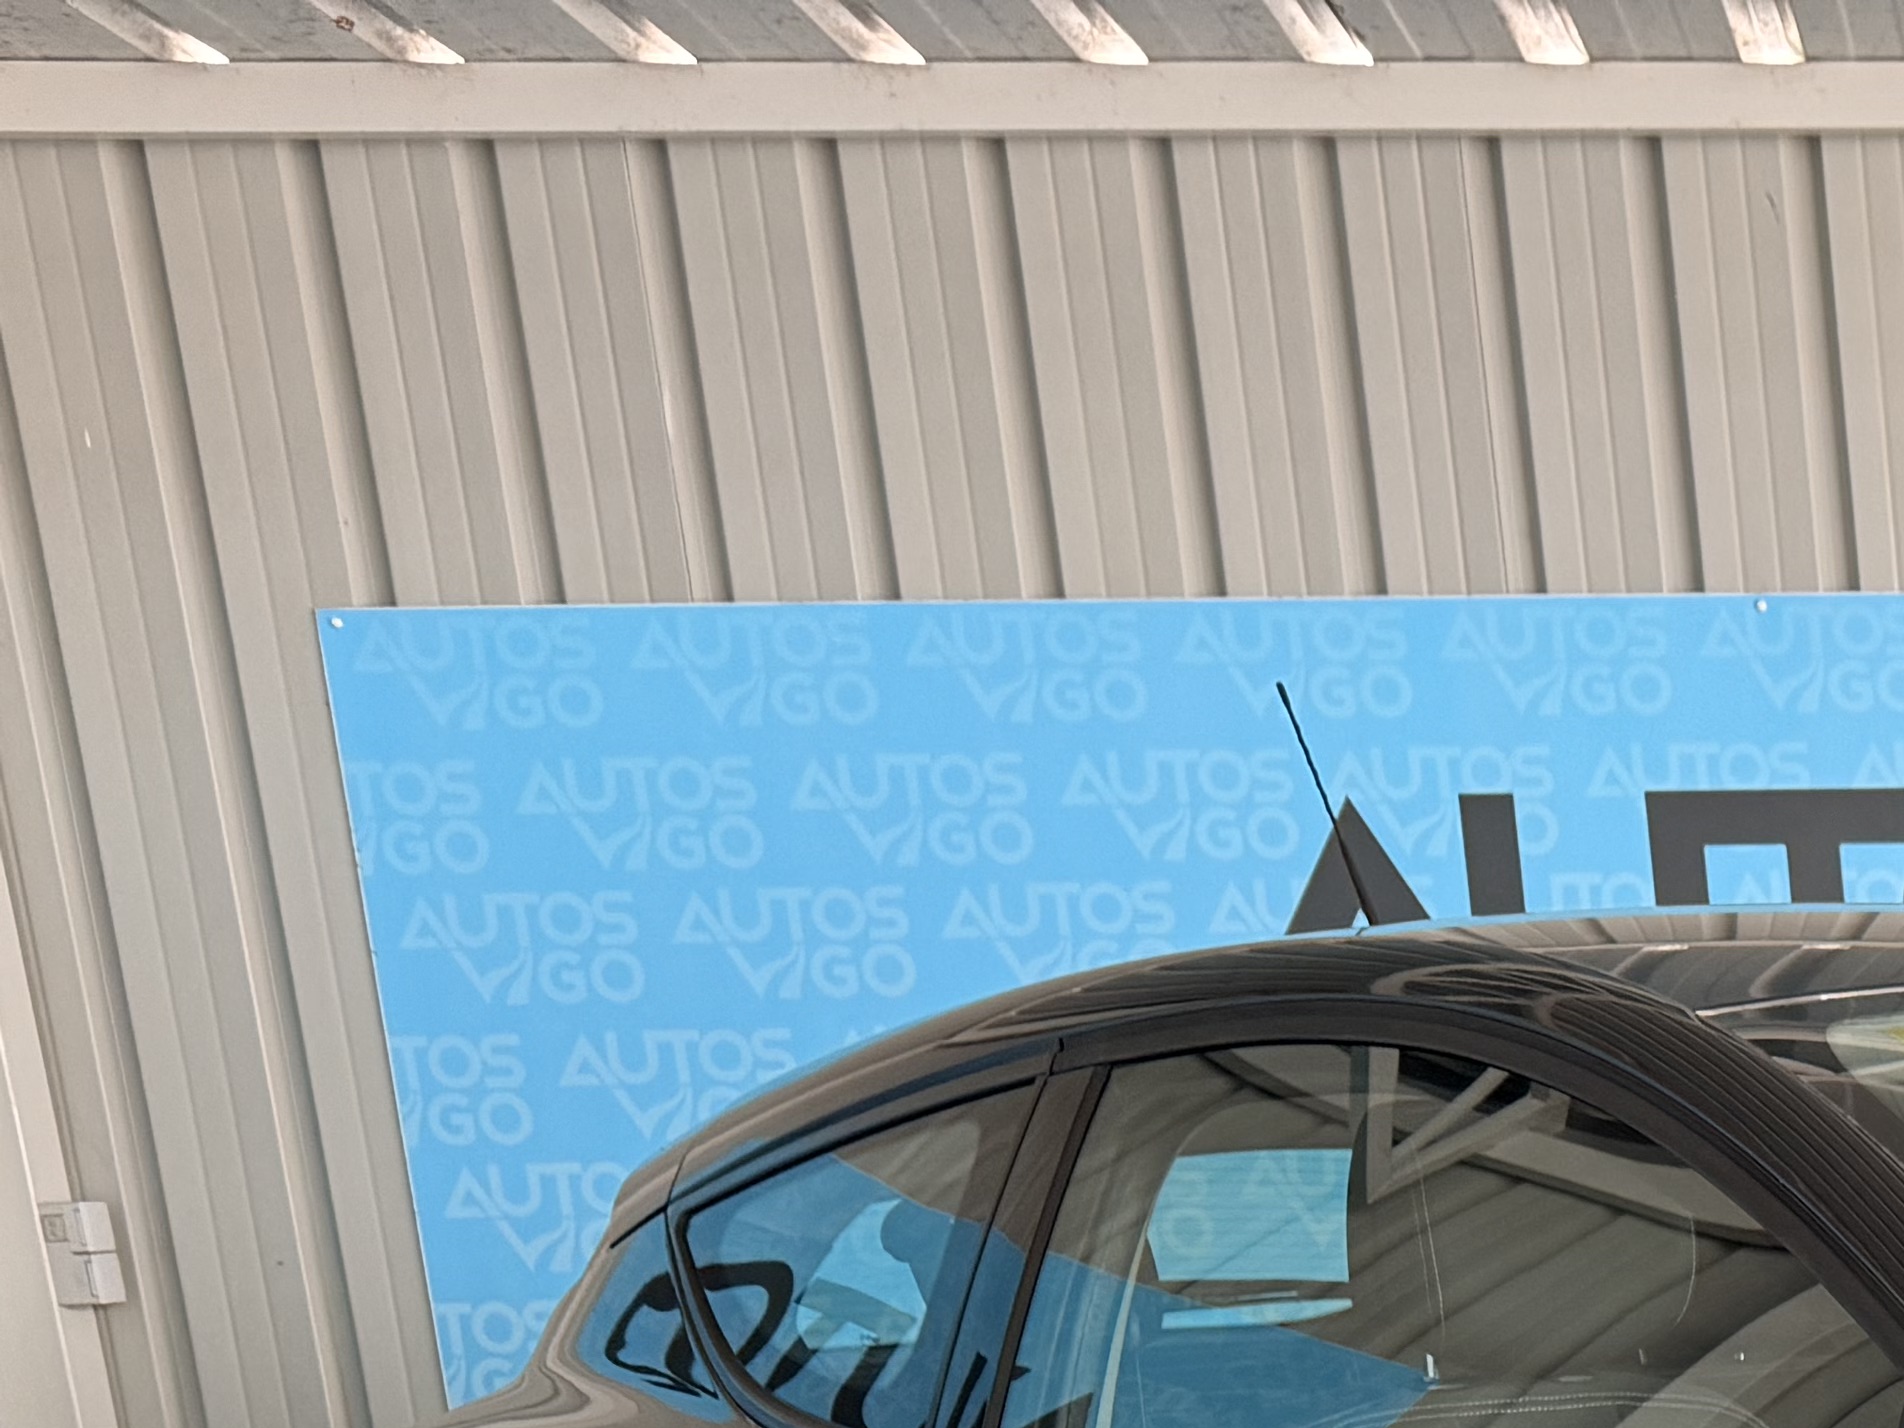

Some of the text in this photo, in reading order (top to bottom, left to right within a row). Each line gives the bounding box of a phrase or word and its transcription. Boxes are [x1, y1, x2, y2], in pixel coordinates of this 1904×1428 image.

[353, 613, 597, 672] AUTOS
[631, 610, 873, 669] AUTOS
[907, 609, 1142, 666] AUTOS
[1175, 608, 1409, 663] AUTOS
[1440, 605, 1669, 660] AUTOS
[345, 760, 484, 816] TOS
[515, 755, 759, 814] AUTOS
[789, 752, 1028, 810] AUTOS
[1061, 748, 1295, 807] AUTOS
[400, 889, 639, 948] AUTOS
[673, 884, 910, 944] AUTOS
[942, 880, 1176, 939] AUTOS
[392, 1032, 527, 1089] TOS
[559, 1026, 798, 1088] AUTOS
[446, 1161, 630, 1220] AUTO
